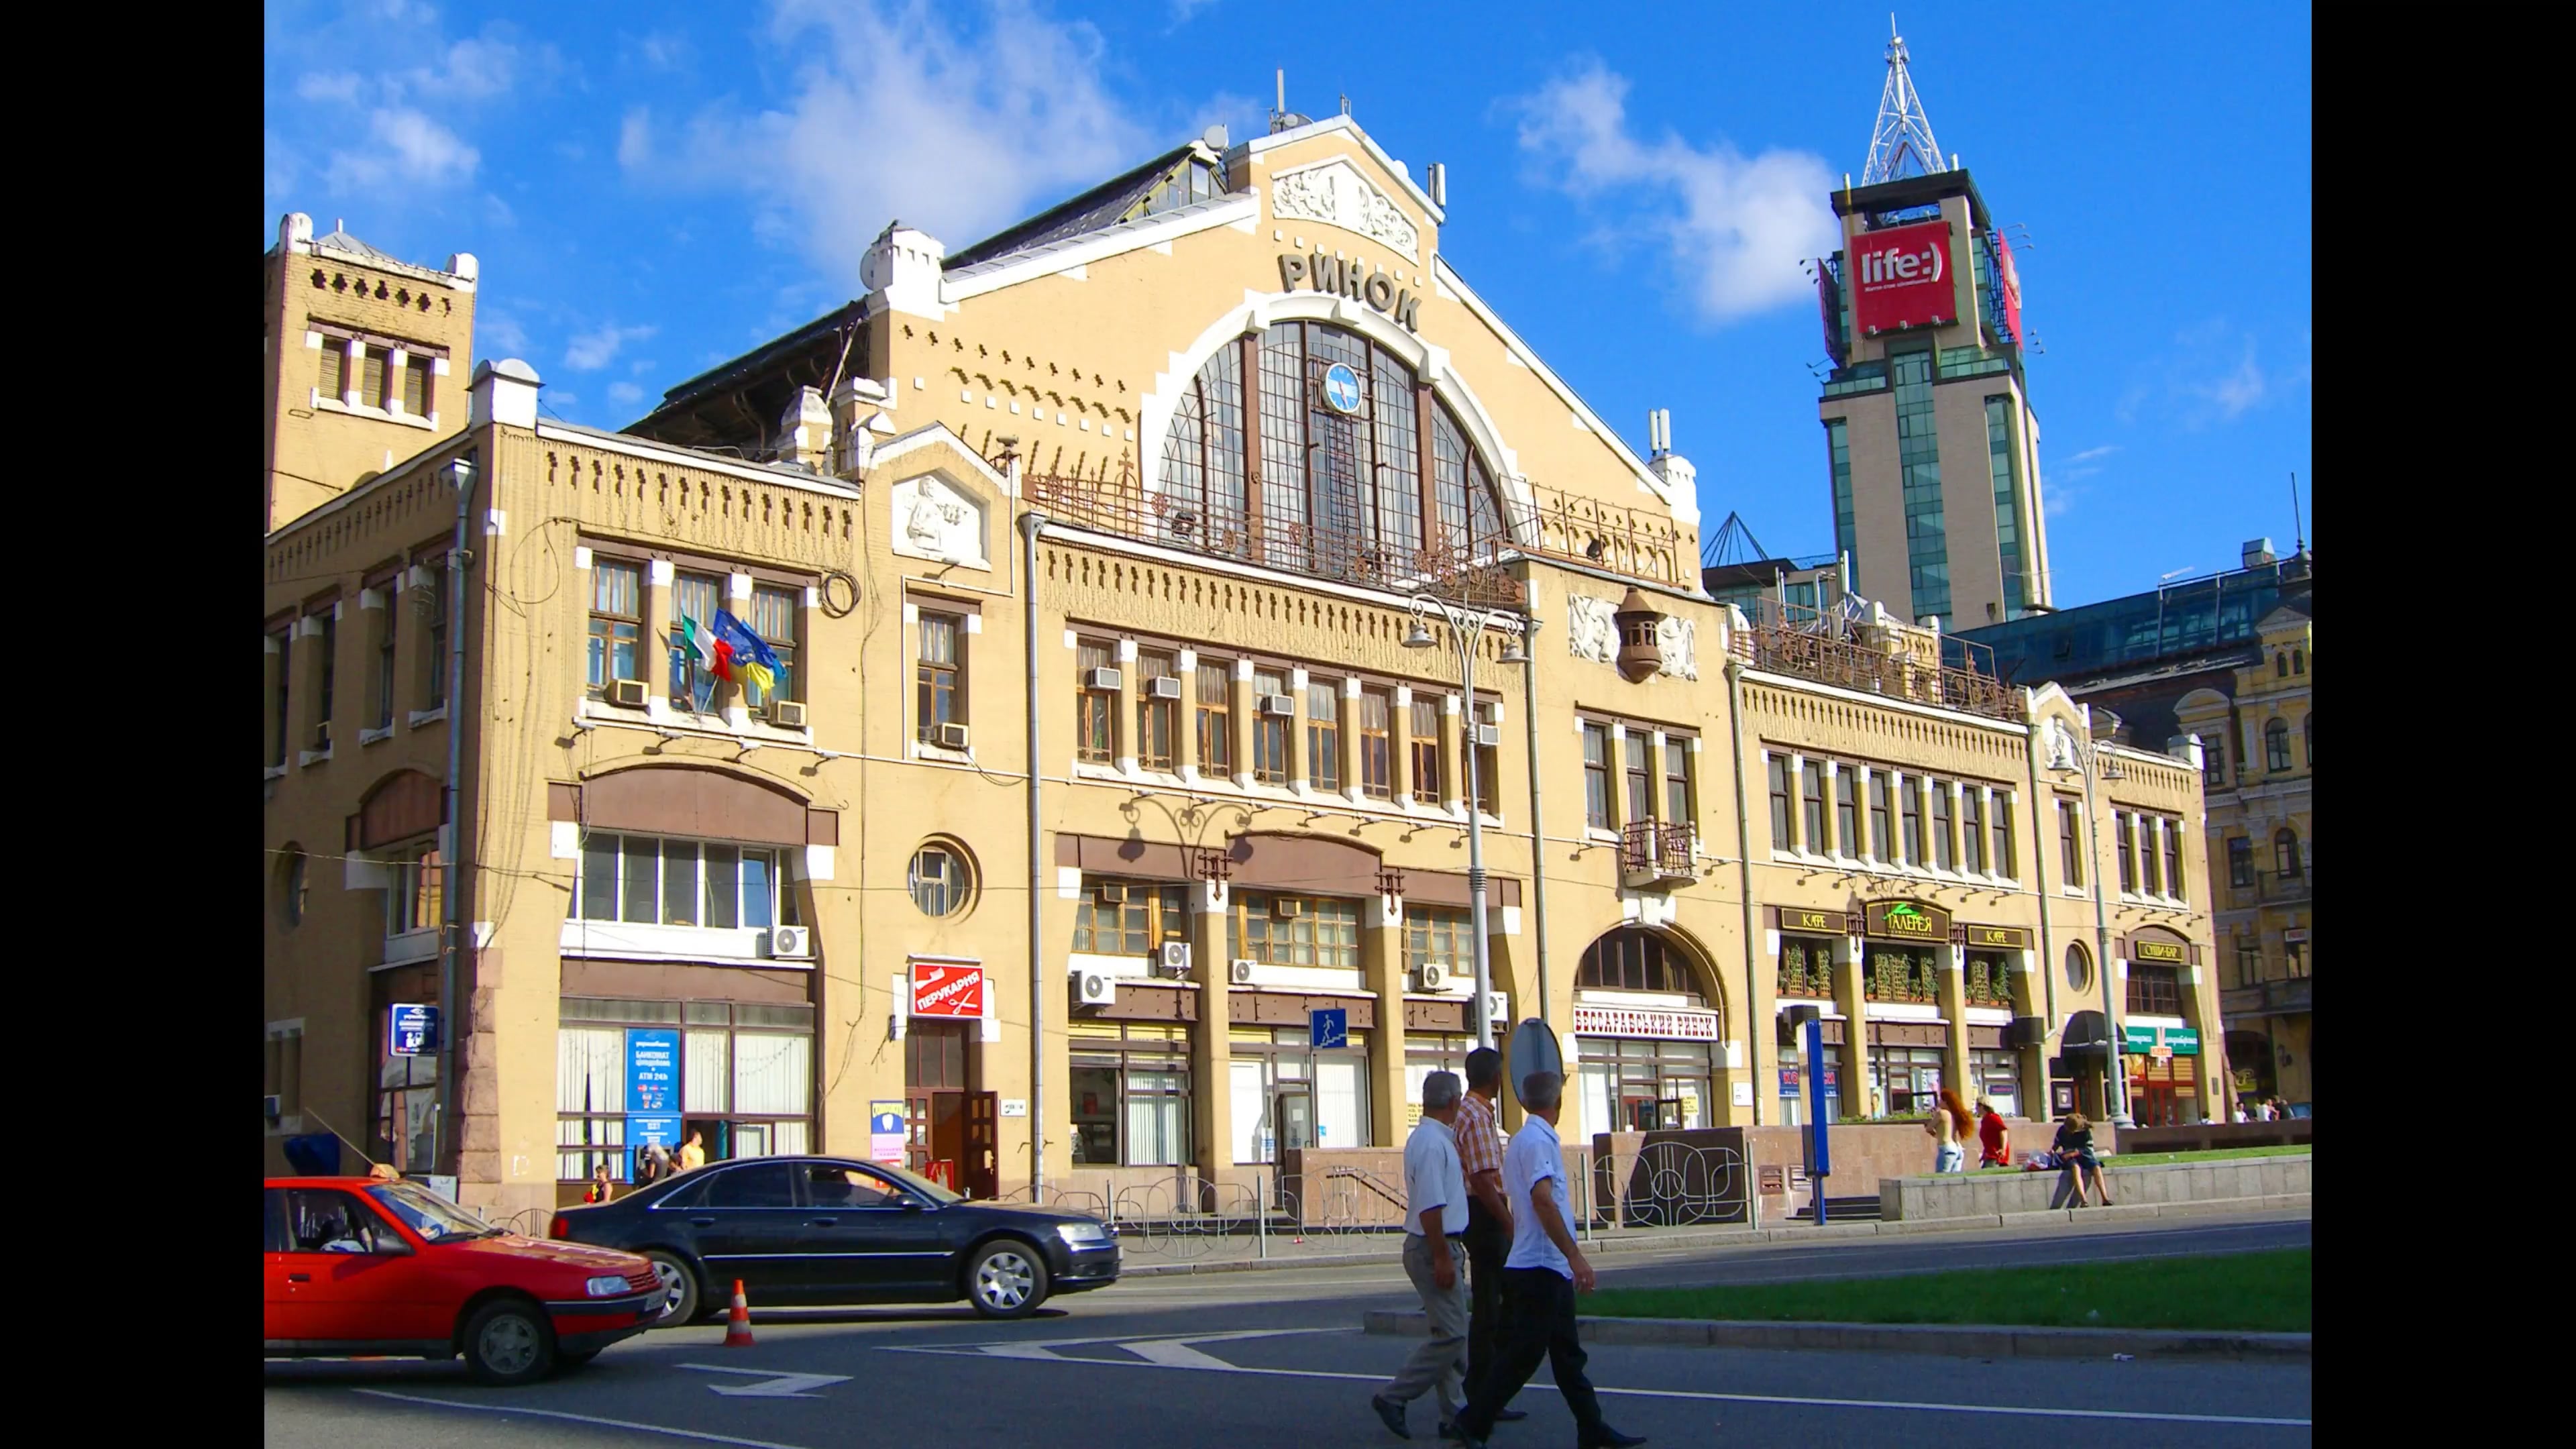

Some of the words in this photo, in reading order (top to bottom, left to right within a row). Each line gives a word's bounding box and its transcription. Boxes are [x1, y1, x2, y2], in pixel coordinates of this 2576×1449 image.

[1862, 241, 1942, 284] life:)
[1278, 253, 1422, 333] РИНОК
[1802, 913, 1827, 928] КАФЕ
[1888, 913, 1933, 932] ГАЛЕРЕЯ
[1986, 930, 2007, 943] КАФЕ
[917, 971, 980, 1011] ПЕРУКАРНЯ
[1575, 1010, 1673, 1036] БЕССАРАБСЬКИЙ
[1676, 1015, 1713, 1036] РИНОК
